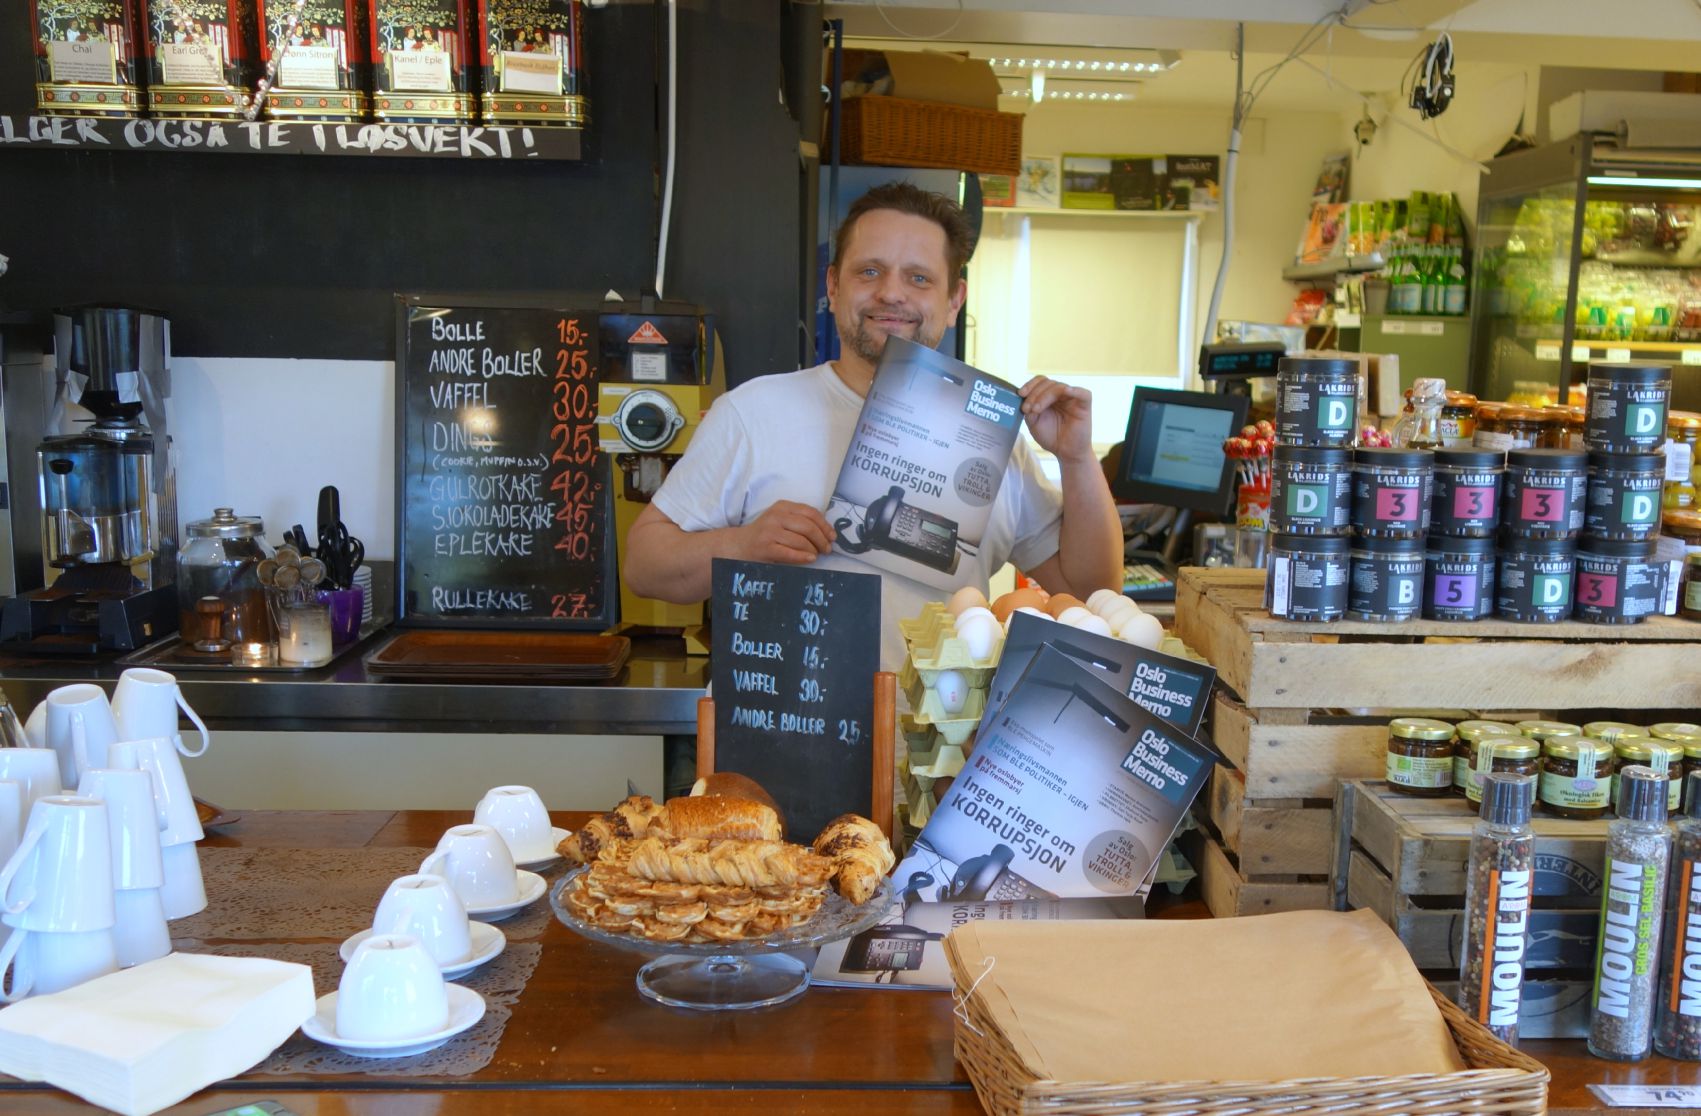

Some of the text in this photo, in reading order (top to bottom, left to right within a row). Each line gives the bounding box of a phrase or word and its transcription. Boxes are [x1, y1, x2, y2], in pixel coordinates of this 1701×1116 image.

[72, 44, 92, 54] Chai
[172, 46, 188, 55] Earl
[309, 49, 334, 59] Sitron
[394, 55, 414, 65] Kanel
[425, 56, 443, 67] Eple
[0, 115, 111, 145] LGER
[238, 121, 291, 150] TE
[432, 316, 486, 342] BOLLE
[429, 348, 477, 376] ANDRE
[482, 347, 548, 378] BOLLER
[430, 380, 497, 410] VAFFEL
[974, 379, 997, 397] Oslo
[967, 401, 1001, 422] Memo
[971, 390, 1016, 416] Business
[1329, 401, 1347, 426] D
[1637, 407, 1657, 433] D
[856, 441, 947, 484] Ingen ringer om
[430, 473, 544, 502] GULROTKAKE
[850, 454, 943, 499] KORRUPSJON
[1288, 472, 1330, 483] LAKRIDS
[1377, 474, 1420, 486] LAKRIDS
[1456, 475, 1495, 486] LAKRIDS
[1523, 476, 1567, 488] LAKRIDS
[1296, 489, 1318, 513] D
[1390, 493, 1407, 517] 3
[1467, 492, 1484, 515] 3
[1534, 494, 1552, 517] 3
[1632, 495, 1652, 520] D
[432, 502, 556, 531] SJOKOLADEKAKE
[435, 531, 533, 557] EPLEKAKE
[1435, 564, 1478, 575] LAKRIDS
[432, 586, 532, 611] RULLEKAKE
[1399, 580, 1414, 604] B
[1446, 580, 1462, 603] 5
[1544, 579, 1563, 603] D
[1587, 579, 1604, 602] 3
[733, 601, 749, 621] TE
[732, 632, 784, 661] BOLLER
[732, 669, 779, 696] VAFFEL
[1136, 662, 1167, 684] Oslo
[1130, 677, 1193, 708] Business
[731, 706, 776, 731] ANDRE
[780, 713, 825, 735] BOLLER
[1141, 729, 1169, 756] Oslo
[984, 758, 1025, 787] Nye oslobyer
[997, 736, 1068, 787] Næringslivsmannen
[1123, 755, 1165, 791] Memo
[1132, 741, 1189, 786] Business
[979, 765, 1023, 795] på fremmarsj
[992, 745, 1010, 761] SOM
[1009, 756, 1025, 770] BLE
[1024, 765, 1063, 795] POLITIKER
[1067, 793, 1089, 812] IGJEN
[963, 775, 1076, 857] Ingen ringer om
[951, 793, 1067, 873] KORRUPSJON
[1118, 836, 1134, 850] Salg
[1108, 842, 1118, 851] av
[1088, 860, 1129, 889] VIKINGER
[1096, 854, 1123, 875] TROLL
[1635, 864, 1658, 976] GROS SEL BASILIC
[1490, 870, 1530, 1026] MOULIN
[1598, 859, 1643, 1018] MOULIN
